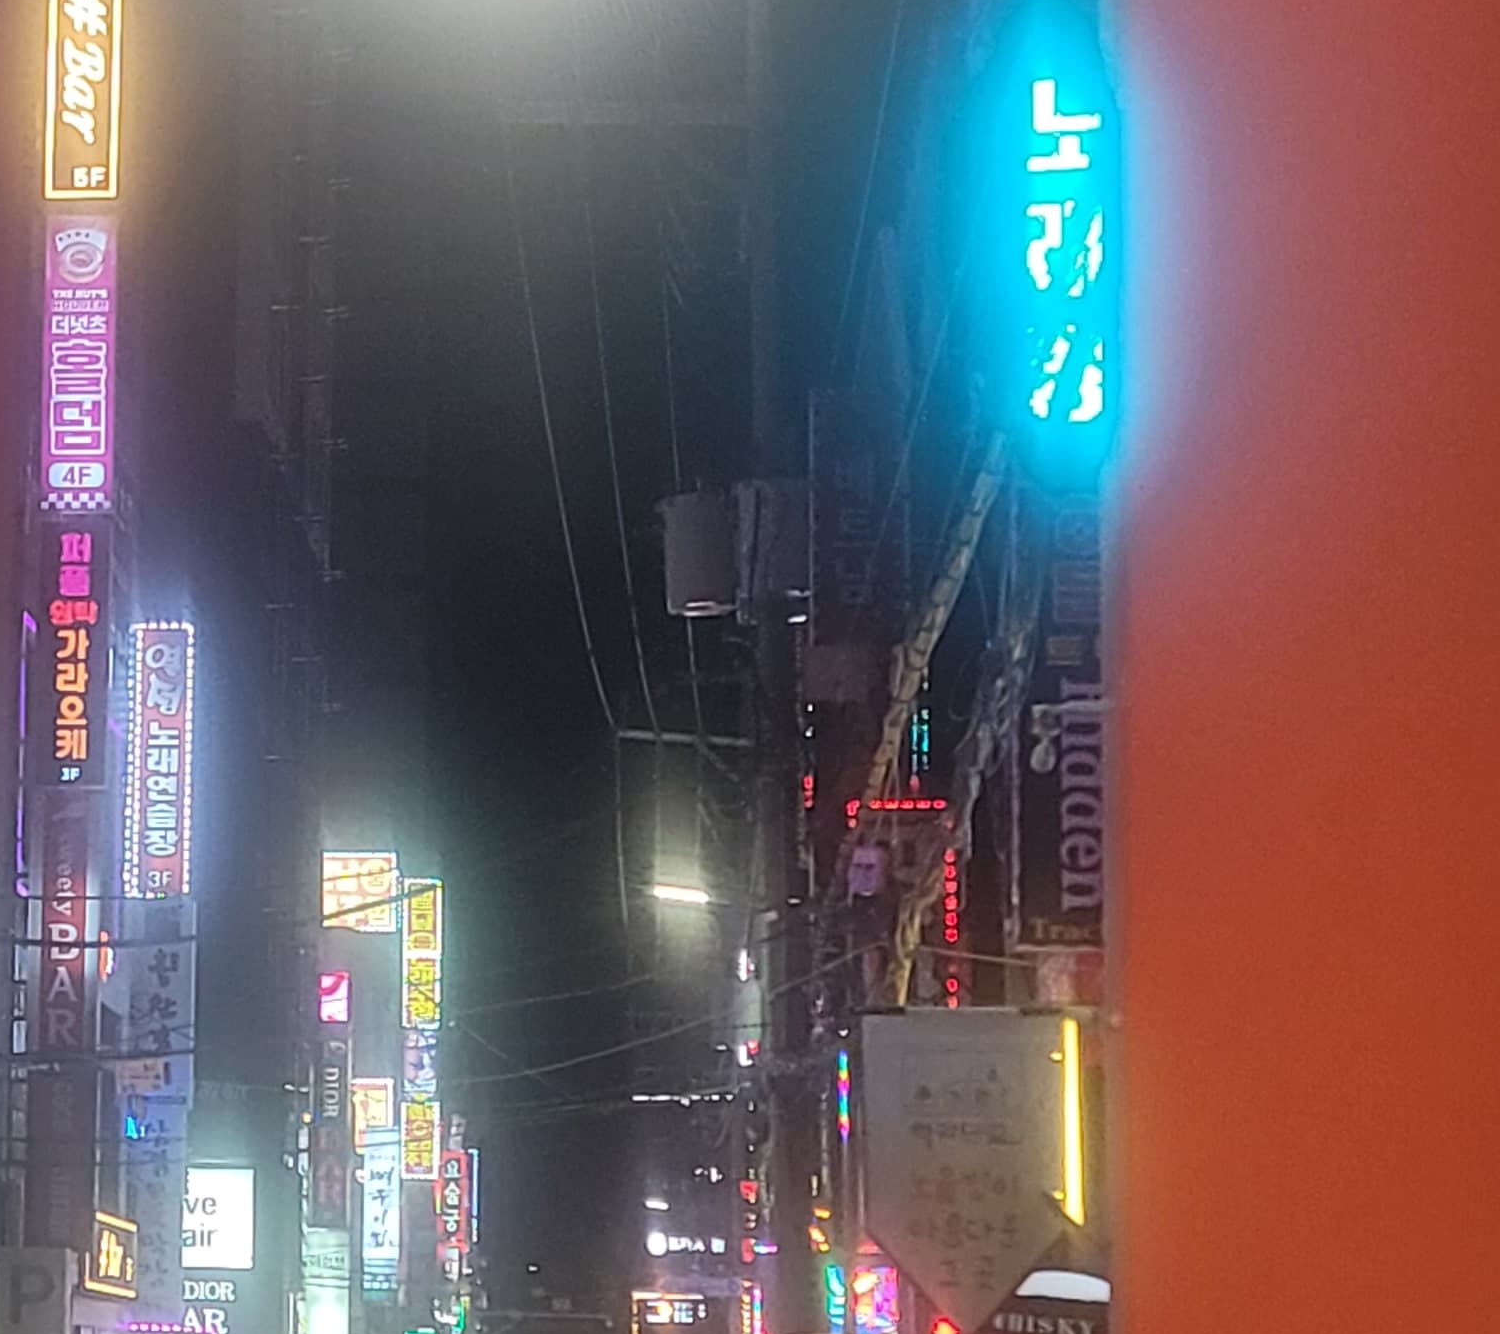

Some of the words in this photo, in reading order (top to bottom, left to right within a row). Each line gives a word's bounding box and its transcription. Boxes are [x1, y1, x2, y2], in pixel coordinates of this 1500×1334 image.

[62, 466, 92, 486] 4F
[55, 628, 90, 761] 가라오케
[144, 720, 181, 858] 노래연습장
[149, 871, 173, 888] 3F
[47, 923, 80, 1046] BAR
[183, 1280, 235, 1301] DIOR
